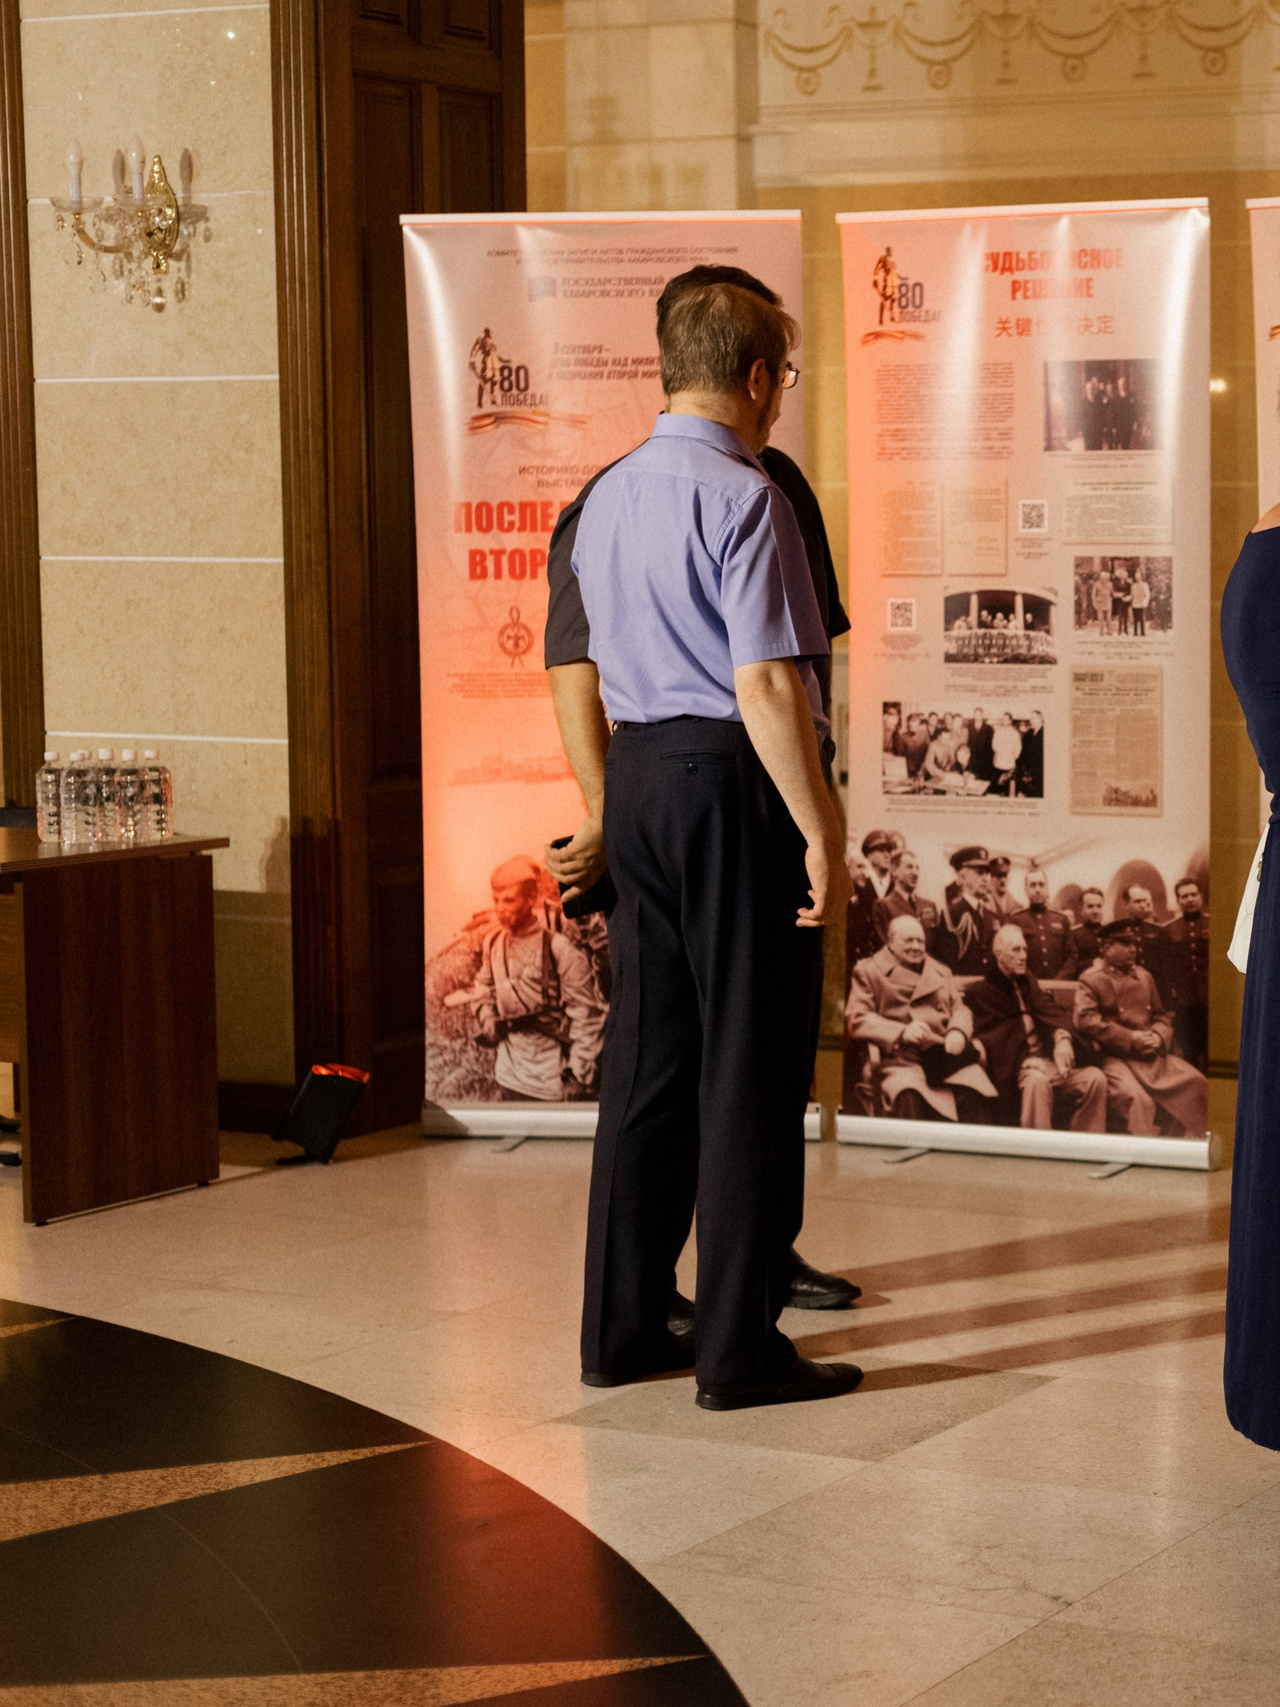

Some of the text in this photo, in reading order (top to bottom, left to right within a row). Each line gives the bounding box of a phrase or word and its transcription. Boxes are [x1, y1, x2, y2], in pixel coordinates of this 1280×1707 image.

[984, 248, 1124, 276] УДЬБОСНОЕ
[898, 282, 924, 309] 80
[995, 314, 1115, 338] 关键决定
[500, 365, 529, 392] 80
[536, 479, 587, 489] ВЫСТАВ
[454, 500, 572, 535] ПОСЛЕ
[468, 548, 547, 581] ВТОР
